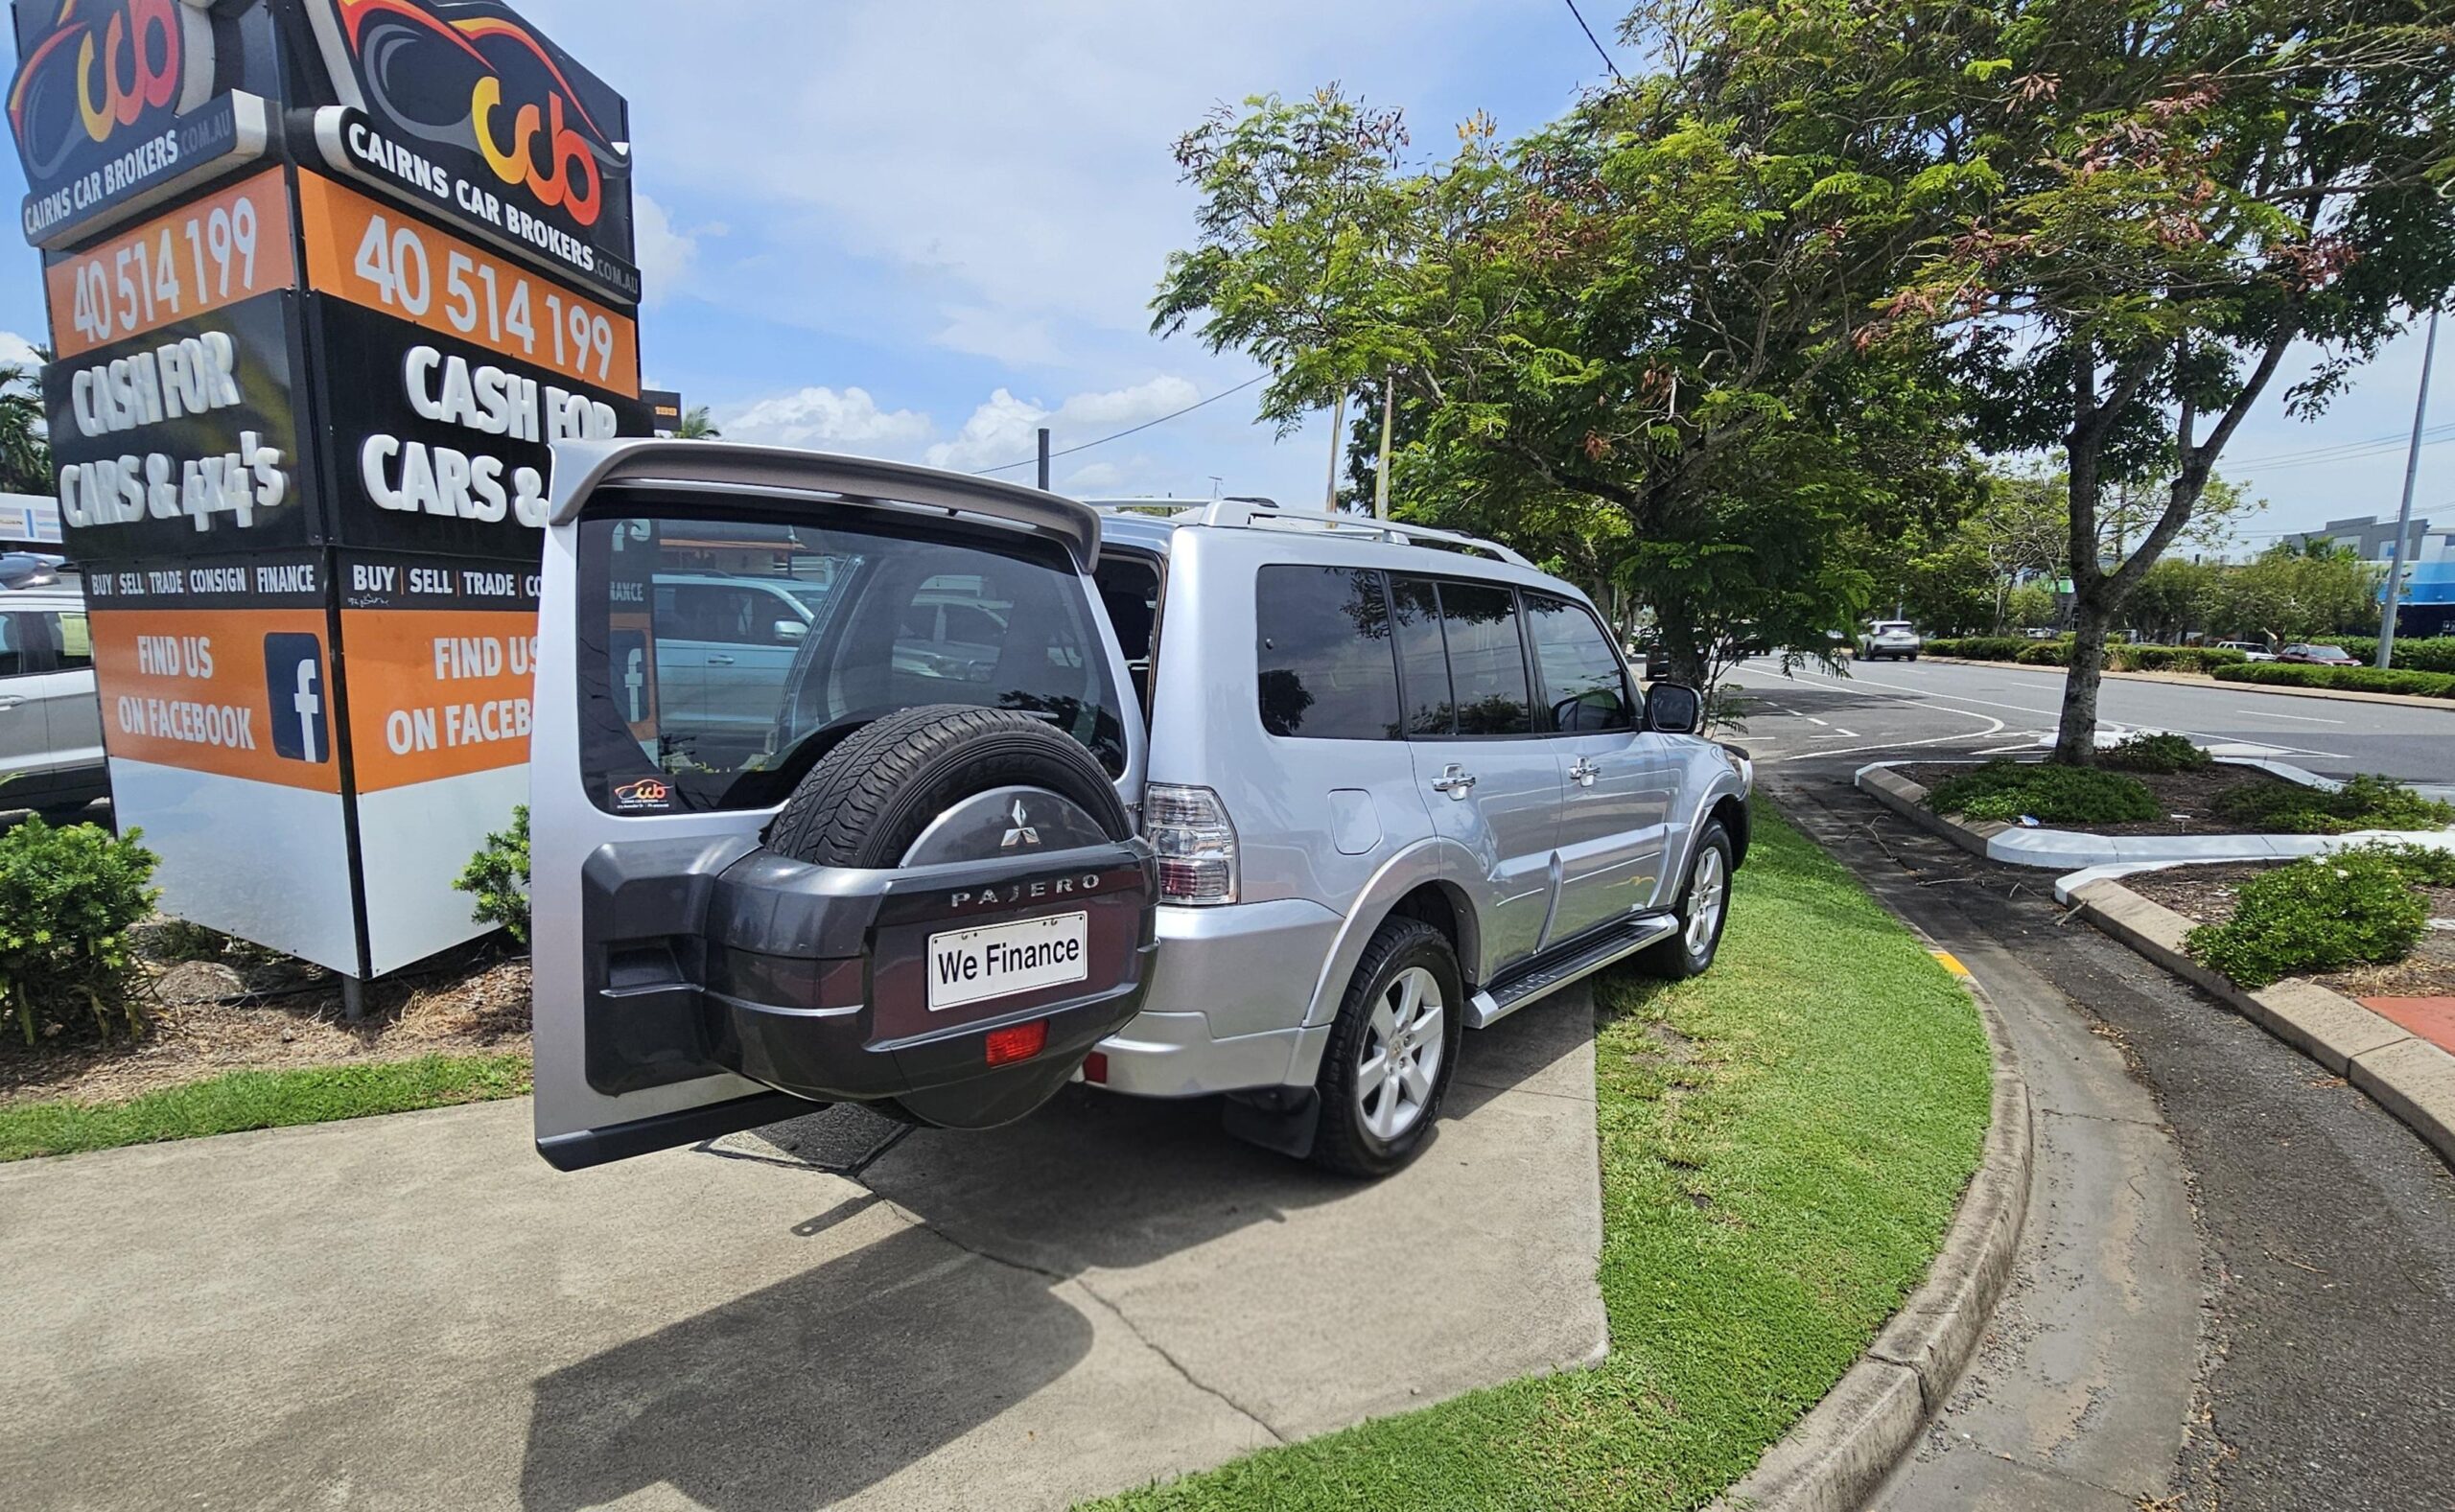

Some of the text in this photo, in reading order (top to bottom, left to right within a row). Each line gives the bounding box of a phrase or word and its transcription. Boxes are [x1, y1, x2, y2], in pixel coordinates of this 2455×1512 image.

[24, 186, 71, 236] CAIRNS
[74, 171, 103, 211] CAR
[348, 123, 449, 198] CAIRNS
[455, 178, 502, 226] CAR
[74, 198, 256, 343] 40 514 199
[354, 214, 614, 383] 40 514 199
[72, 331, 241, 437] CASH FOR
[405, 345, 539, 443] CASH
[59, 454, 145, 527] CARS
[146, 453, 182, 519] &
[362, 433, 507, 523] CARS
[92, 564, 316, 595] BUY SELL TRADE CONSIGN FINANCE
[353, 564, 395, 592] BUY
[409, 568, 453, 593] SELL
[463, 571, 515, 596] TRADE
[137, 636, 180, 676] FIND
[182, 637, 214, 679] US
[434, 638, 503, 680] FIND
[118, 696, 256, 750] ON FACEBOOK
[386, 708, 437, 755] ON
[950, 873, 1100, 908] PAJERO
[938, 937, 1080, 985] We Finance
